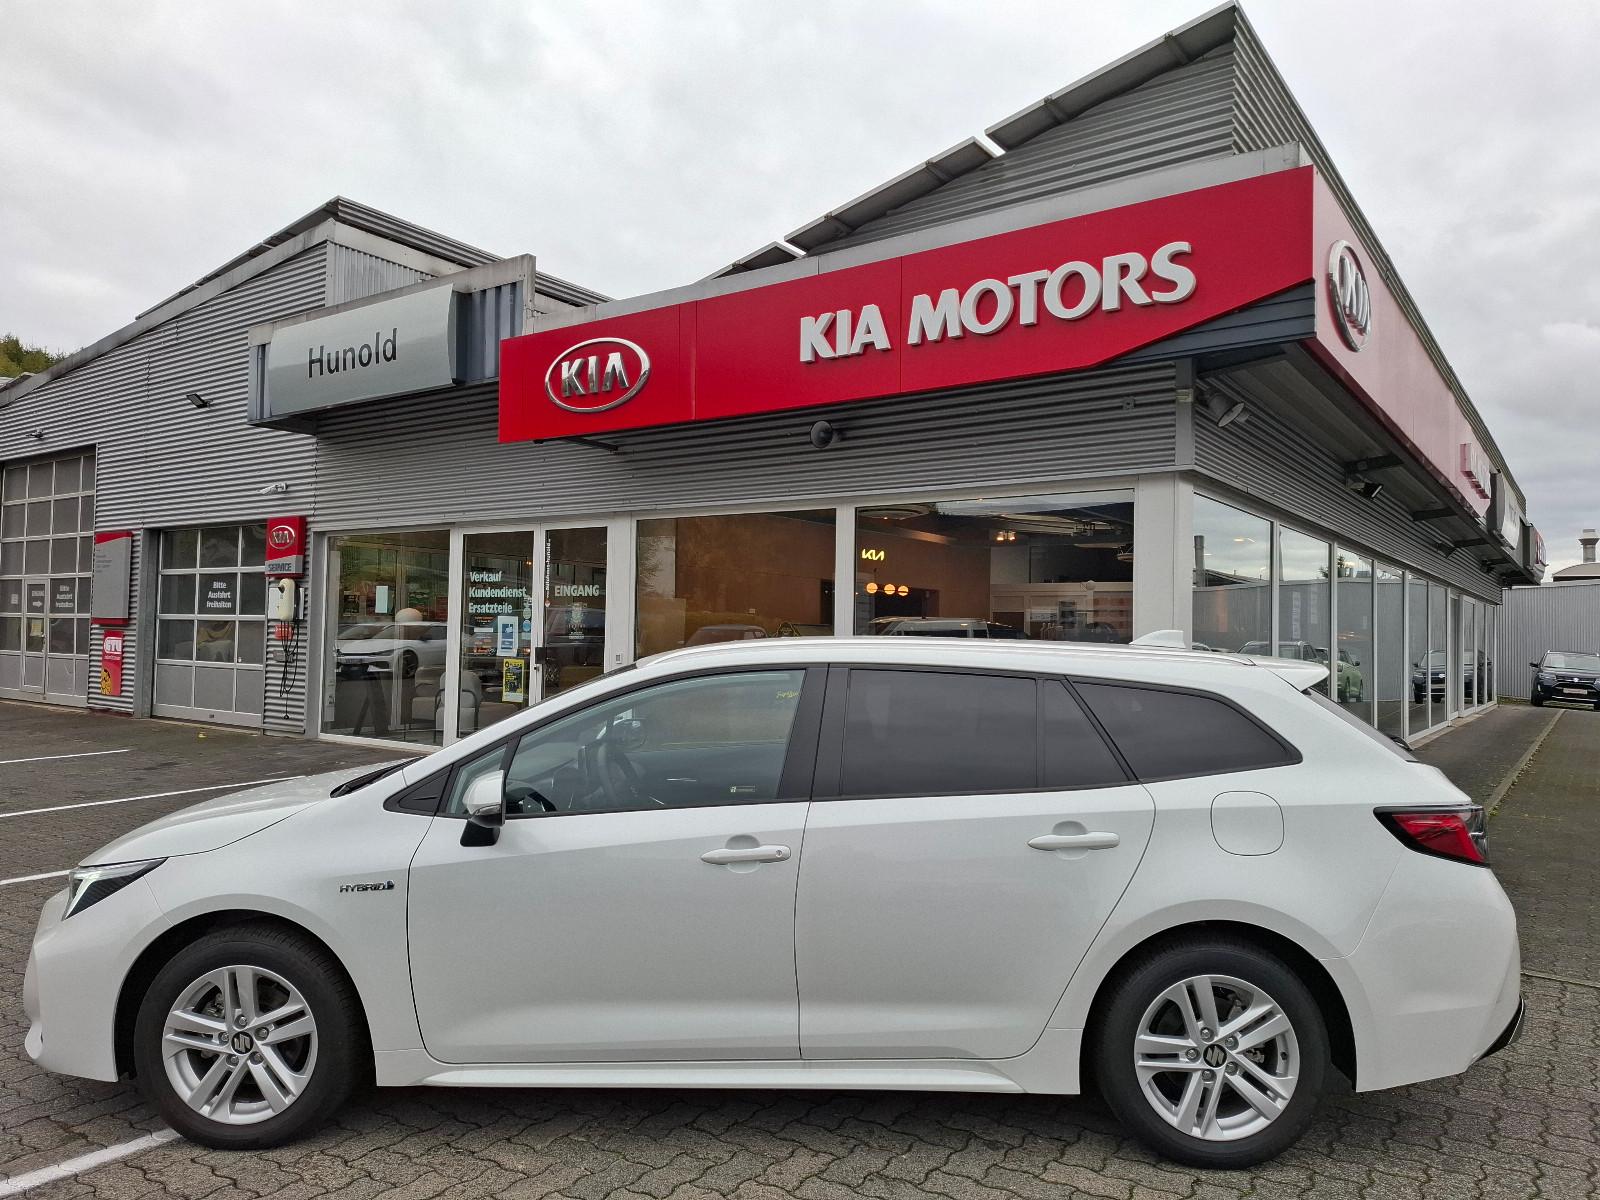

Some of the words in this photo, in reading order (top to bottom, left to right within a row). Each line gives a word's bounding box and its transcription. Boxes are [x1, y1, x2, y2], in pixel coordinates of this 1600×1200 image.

[800, 304, 891, 363] KIA
[907, 241, 1197, 346] MOTORS
[308, 327, 397, 378] Hunold
[561, 352, 629, 397] KIA
[267, 562, 292, 573] SERVICE
[469, 570, 502, 582] Verkauf
[212, 581, 227, 589] Bitte
[554, 584, 600, 597] EINGANG
[207, 591, 231, 599] Ausfahrt
[468, 586, 527, 598] Kundendienst
[468, 602, 513, 614] Ersatzteile
[340, 882, 385, 892] HYBRID
